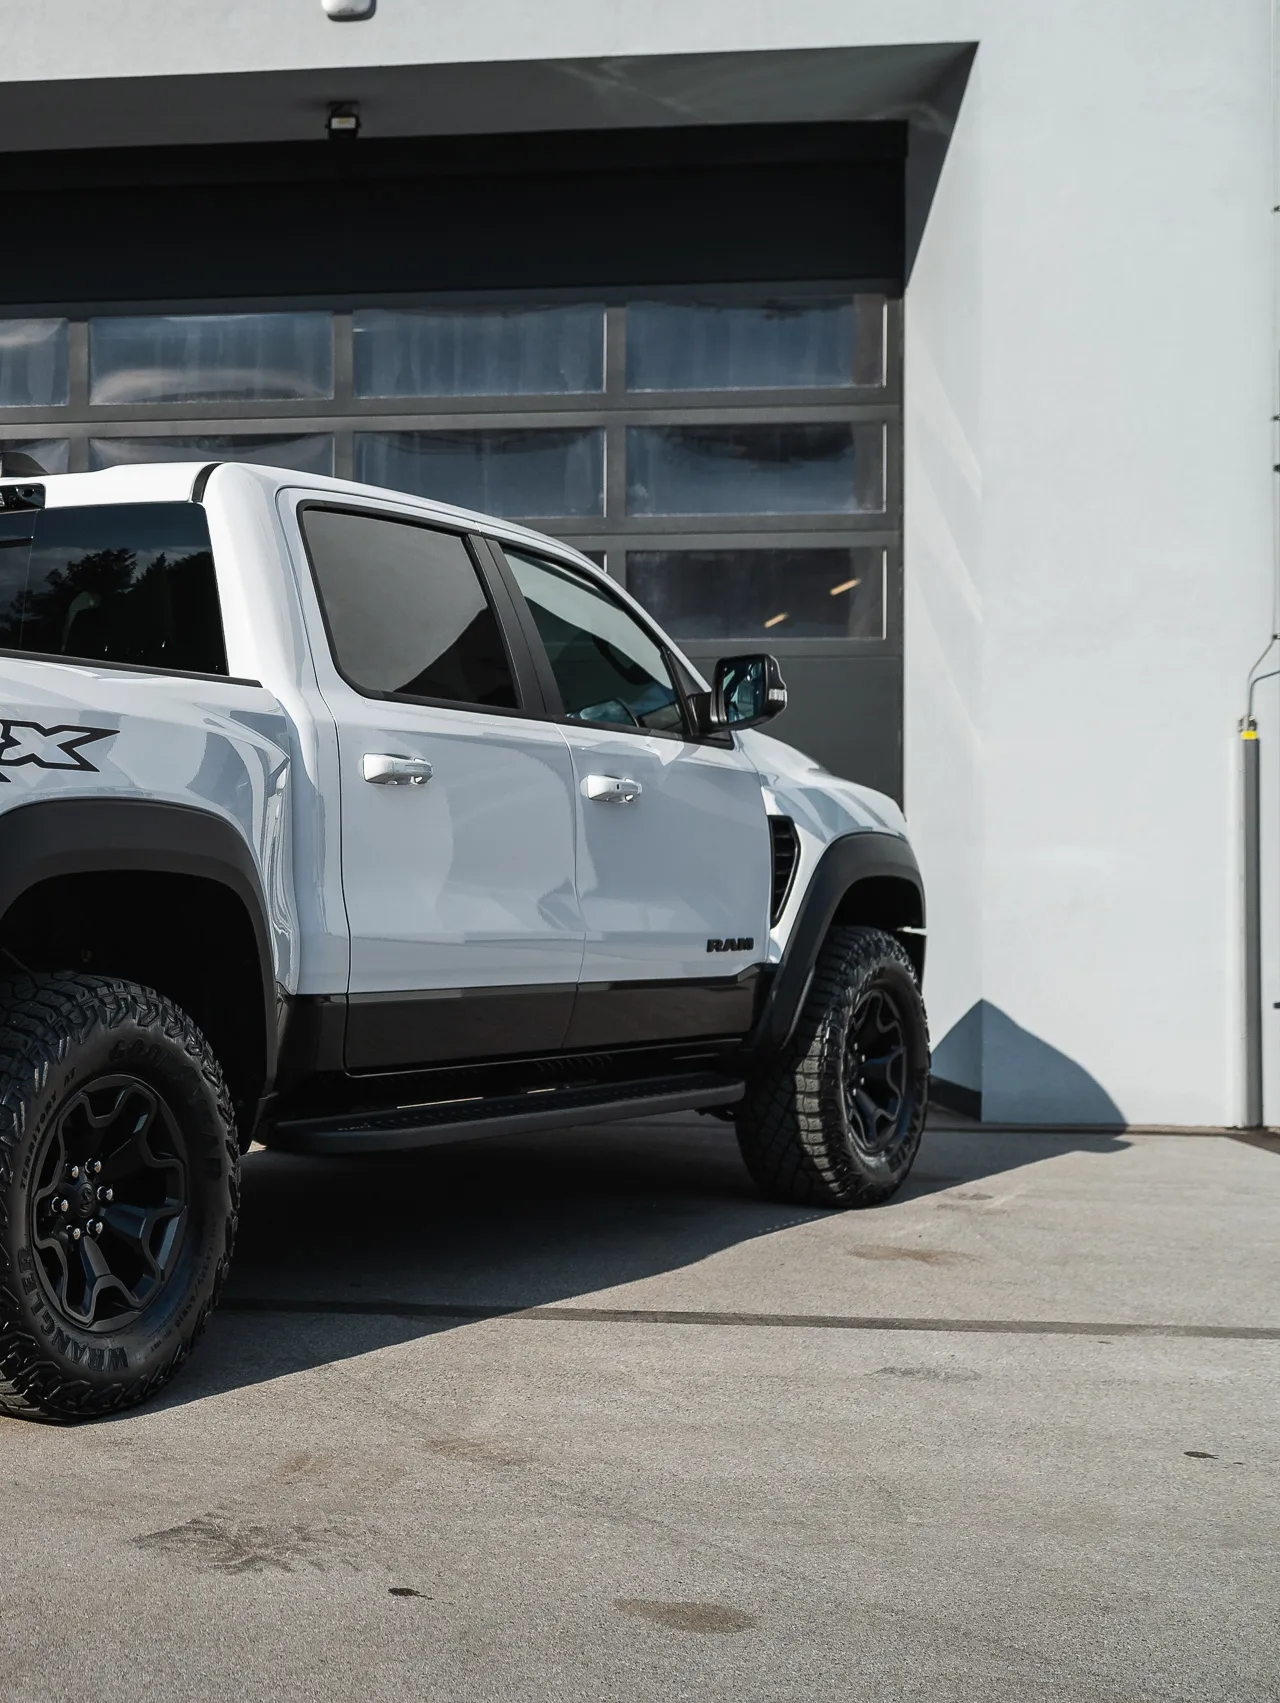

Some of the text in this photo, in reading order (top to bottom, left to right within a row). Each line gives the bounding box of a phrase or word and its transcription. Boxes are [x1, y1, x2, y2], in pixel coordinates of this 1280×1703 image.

[706, 937, 754, 953] RAM
[19, 1090, 57, 1190] TERRITORY
[17, 1246, 129, 1372] WRANGLER
